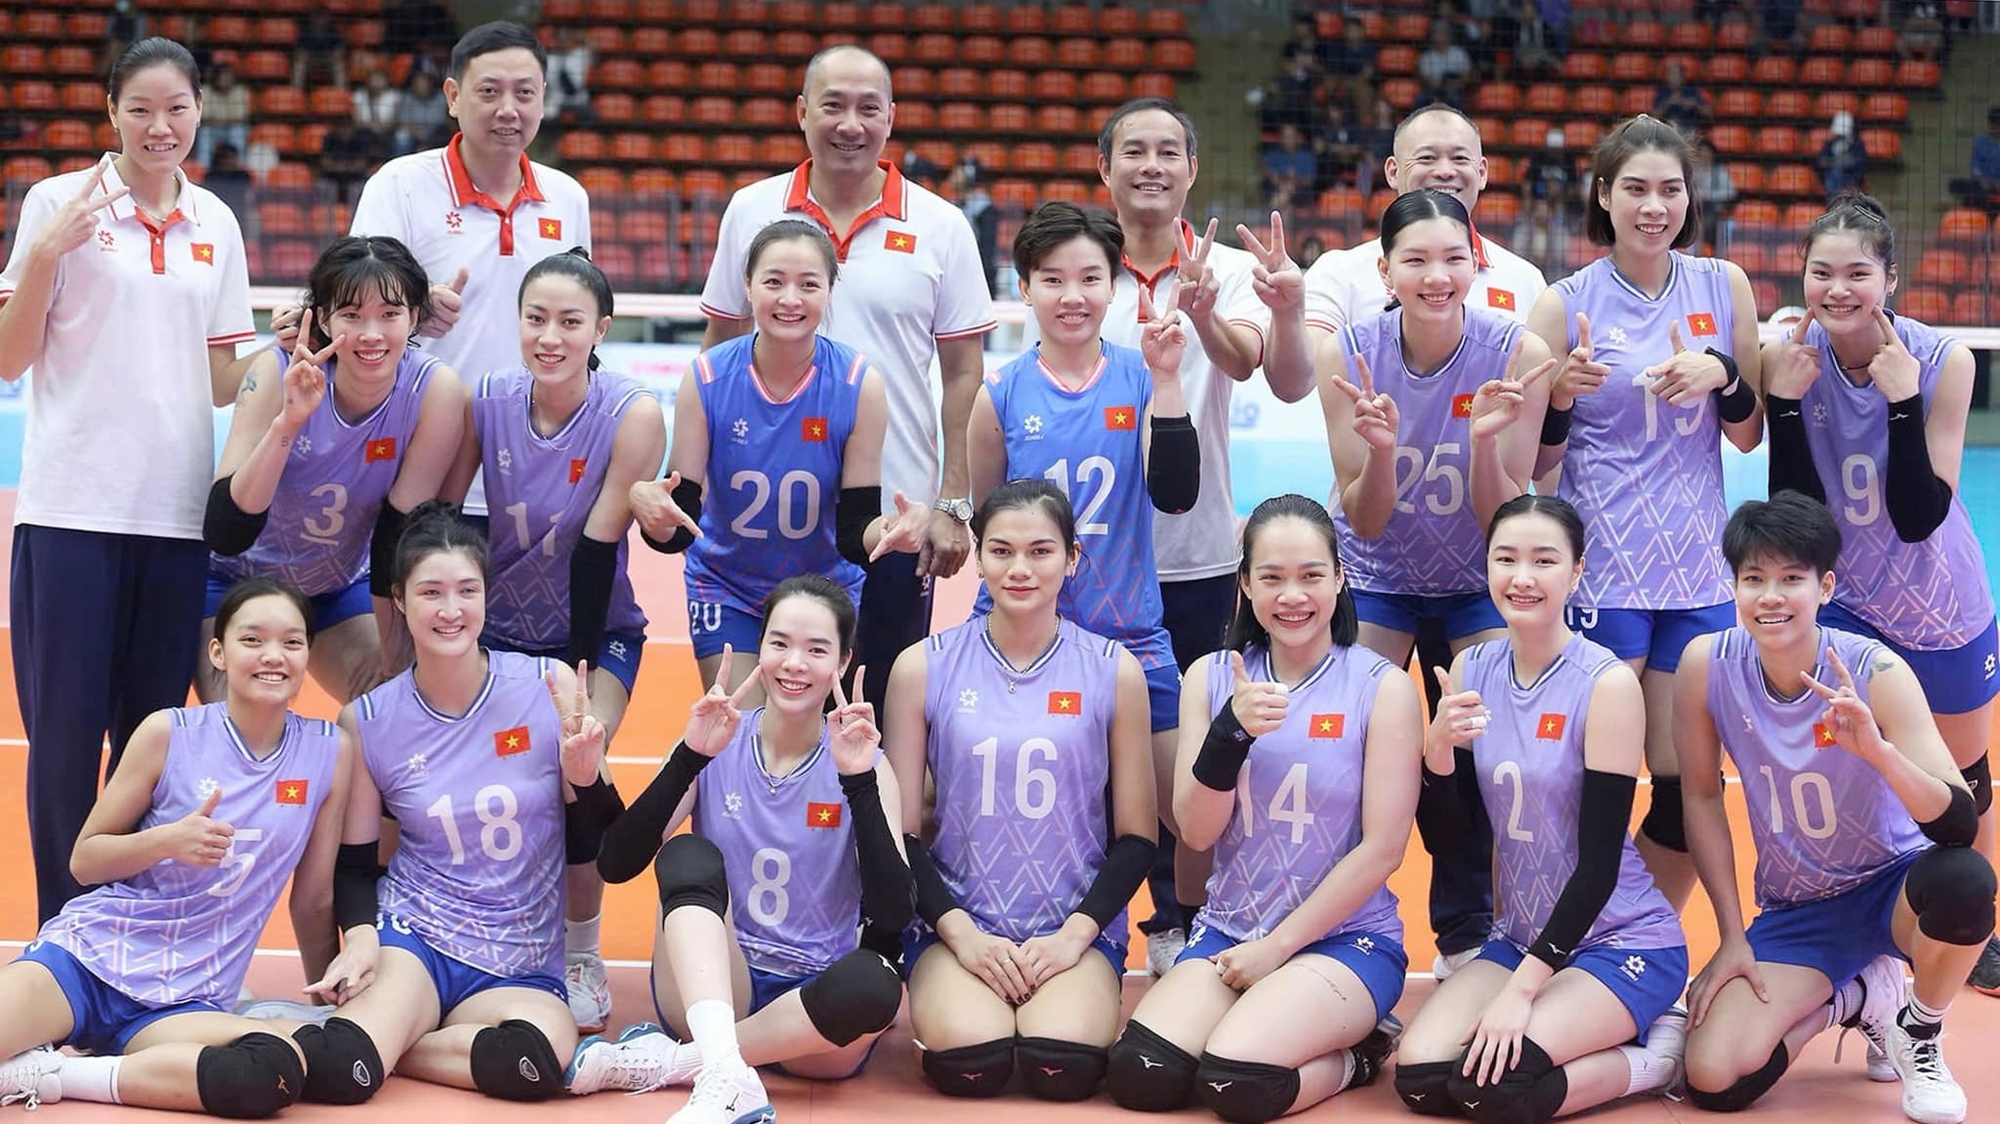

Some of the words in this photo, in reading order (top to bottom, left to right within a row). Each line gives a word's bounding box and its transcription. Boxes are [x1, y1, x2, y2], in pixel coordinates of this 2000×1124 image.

[303, 483, 348, 538] 3
[727, 470, 821, 541] 20
[1043, 456, 1116, 536] 12
[1397, 443, 1465, 516] 25
[1841, 454, 1881, 526] 9
[505, 501, 565, 557] 11
[689, 600, 722, 635] 20
[972, 736, 1058, 819] 16
[1237, 758, 1314, 844] 14
[1493, 760, 1535, 842] 2
[1760, 764, 1847, 839] 10
[426, 784, 523, 865] 18
[207, 828, 263, 898] 5
[747, 847, 792, 927] 8
